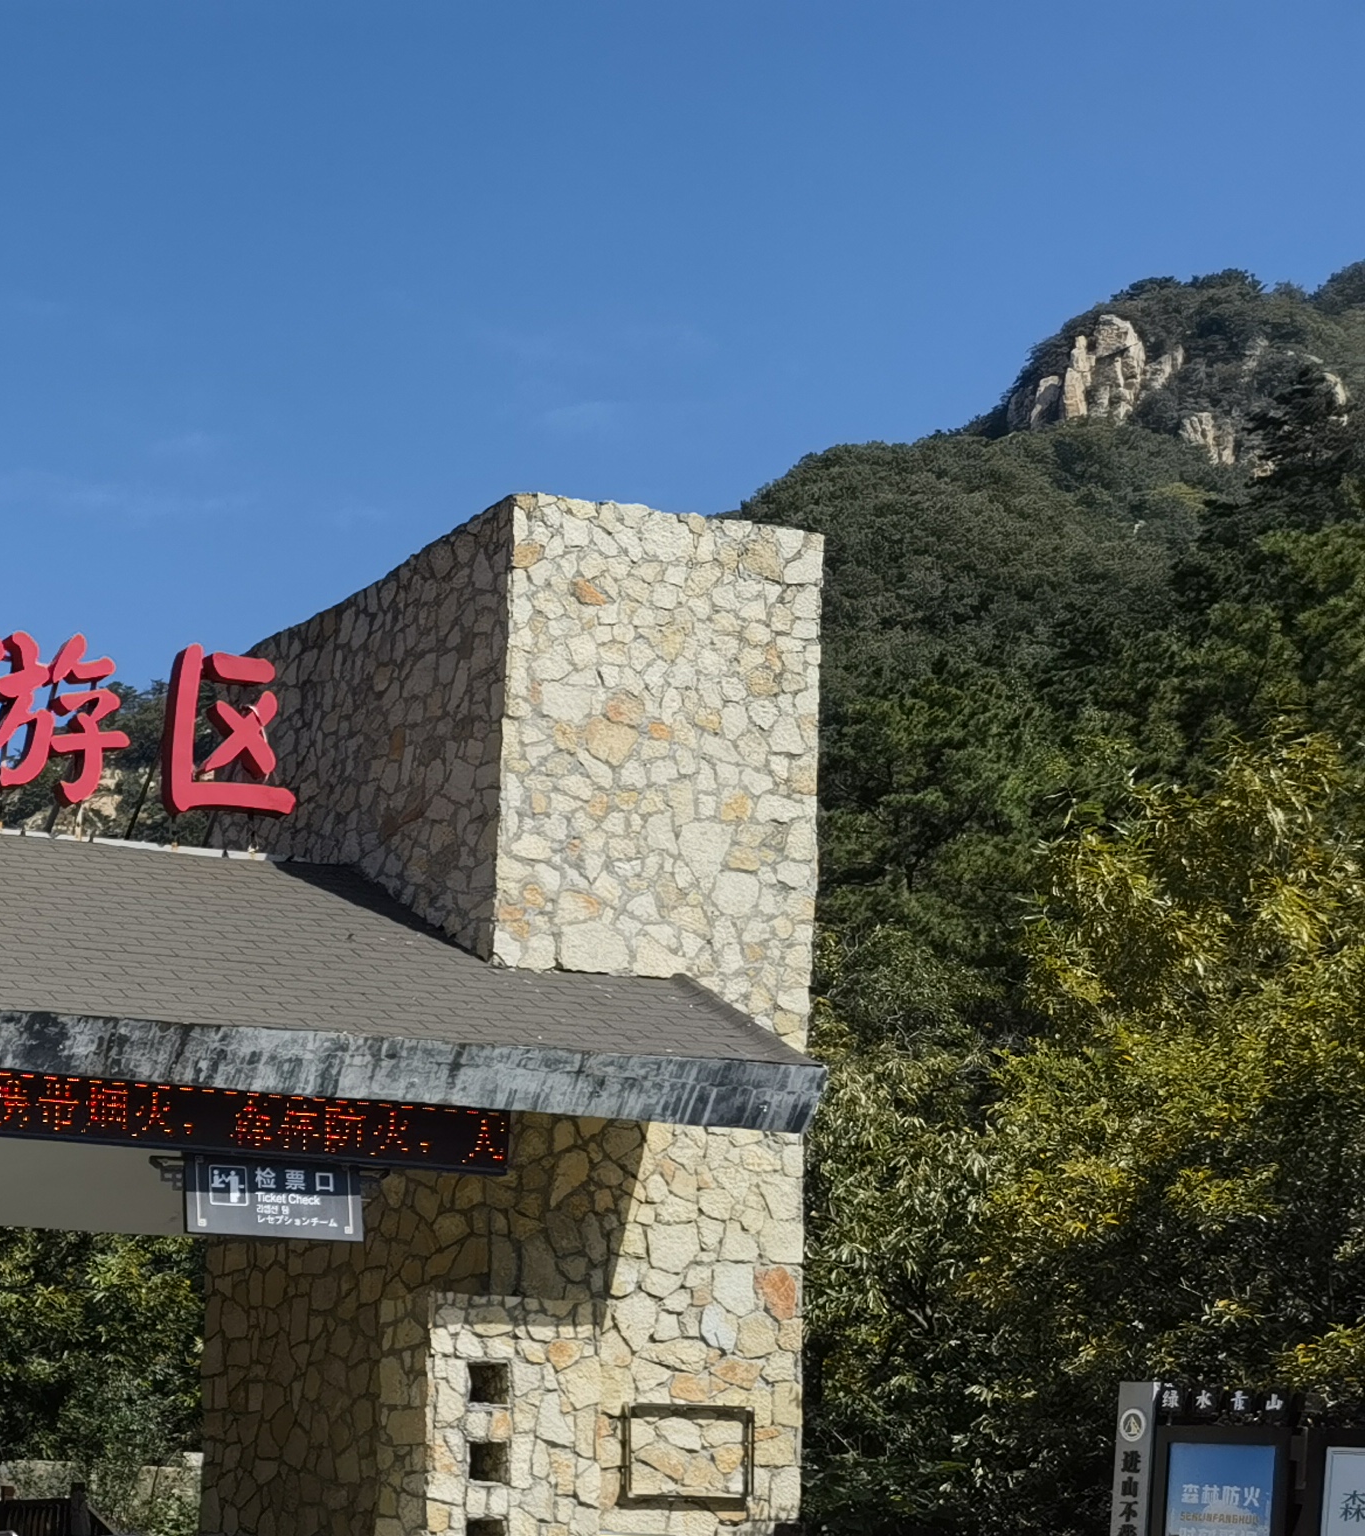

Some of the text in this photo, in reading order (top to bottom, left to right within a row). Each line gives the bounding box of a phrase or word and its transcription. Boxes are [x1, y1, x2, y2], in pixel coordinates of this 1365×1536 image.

[254, 1167, 334, 1192] 检票口
[254, 1192, 321, 1206] Ticket Check
[1161, 1389, 1284, 1411] 绿水青山
[1181, 1484, 1261, 1507] 森林防火
